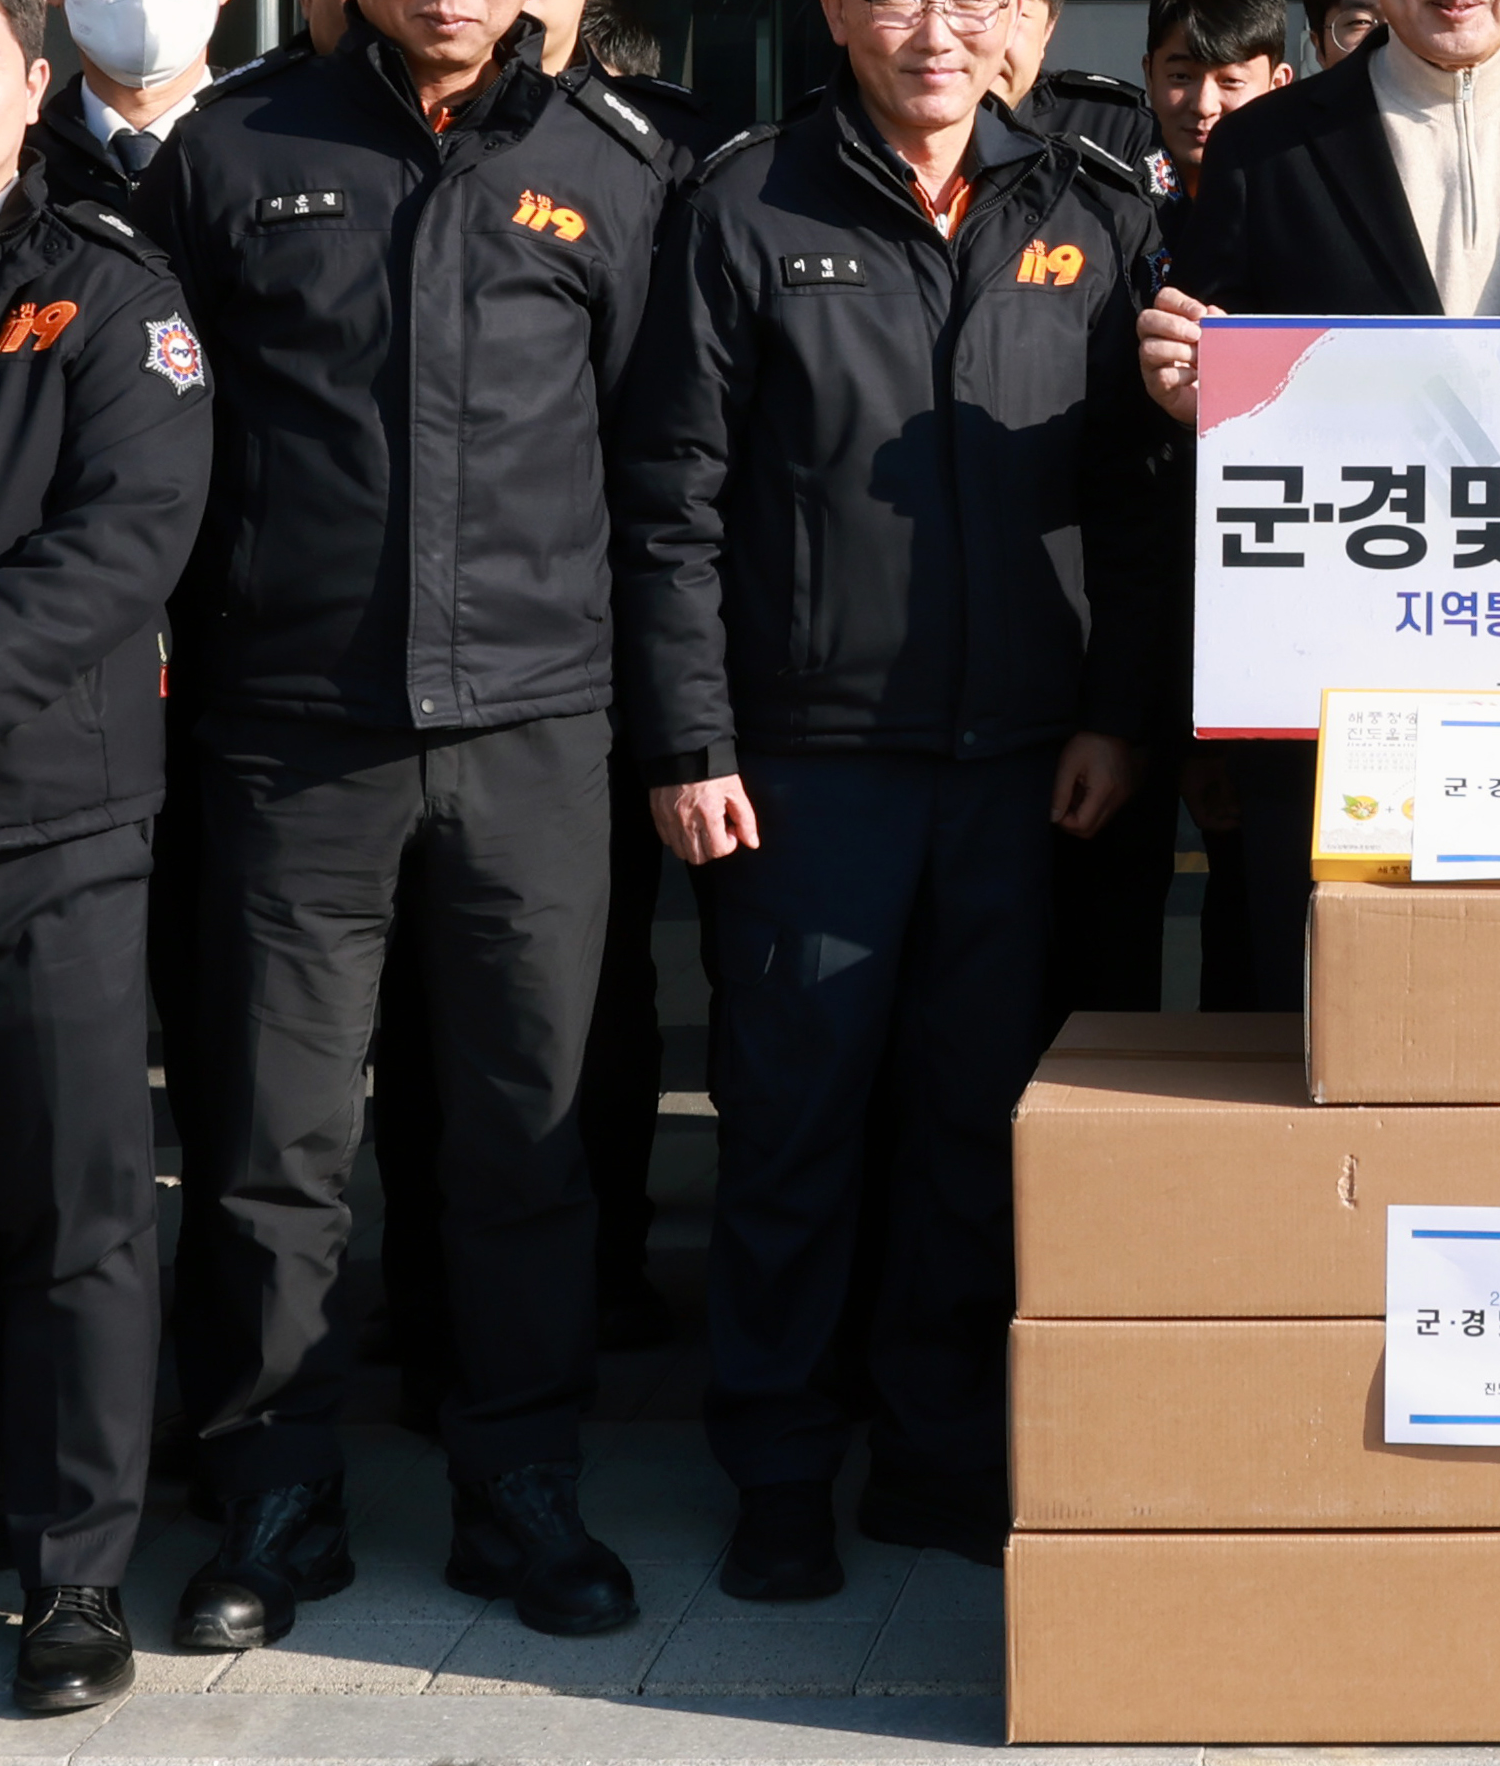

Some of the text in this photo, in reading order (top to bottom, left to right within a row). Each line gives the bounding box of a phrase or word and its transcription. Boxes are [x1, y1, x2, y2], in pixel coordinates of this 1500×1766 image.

[294, 206, 310, 214] LEE
[519, 189, 553, 211] 소방
[512, 201, 586, 243] 119
[821, 270, 835, 278] LEE
[1016, 244, 1085, 287] 119
[1216, 464, 1428, 570] 군·경
